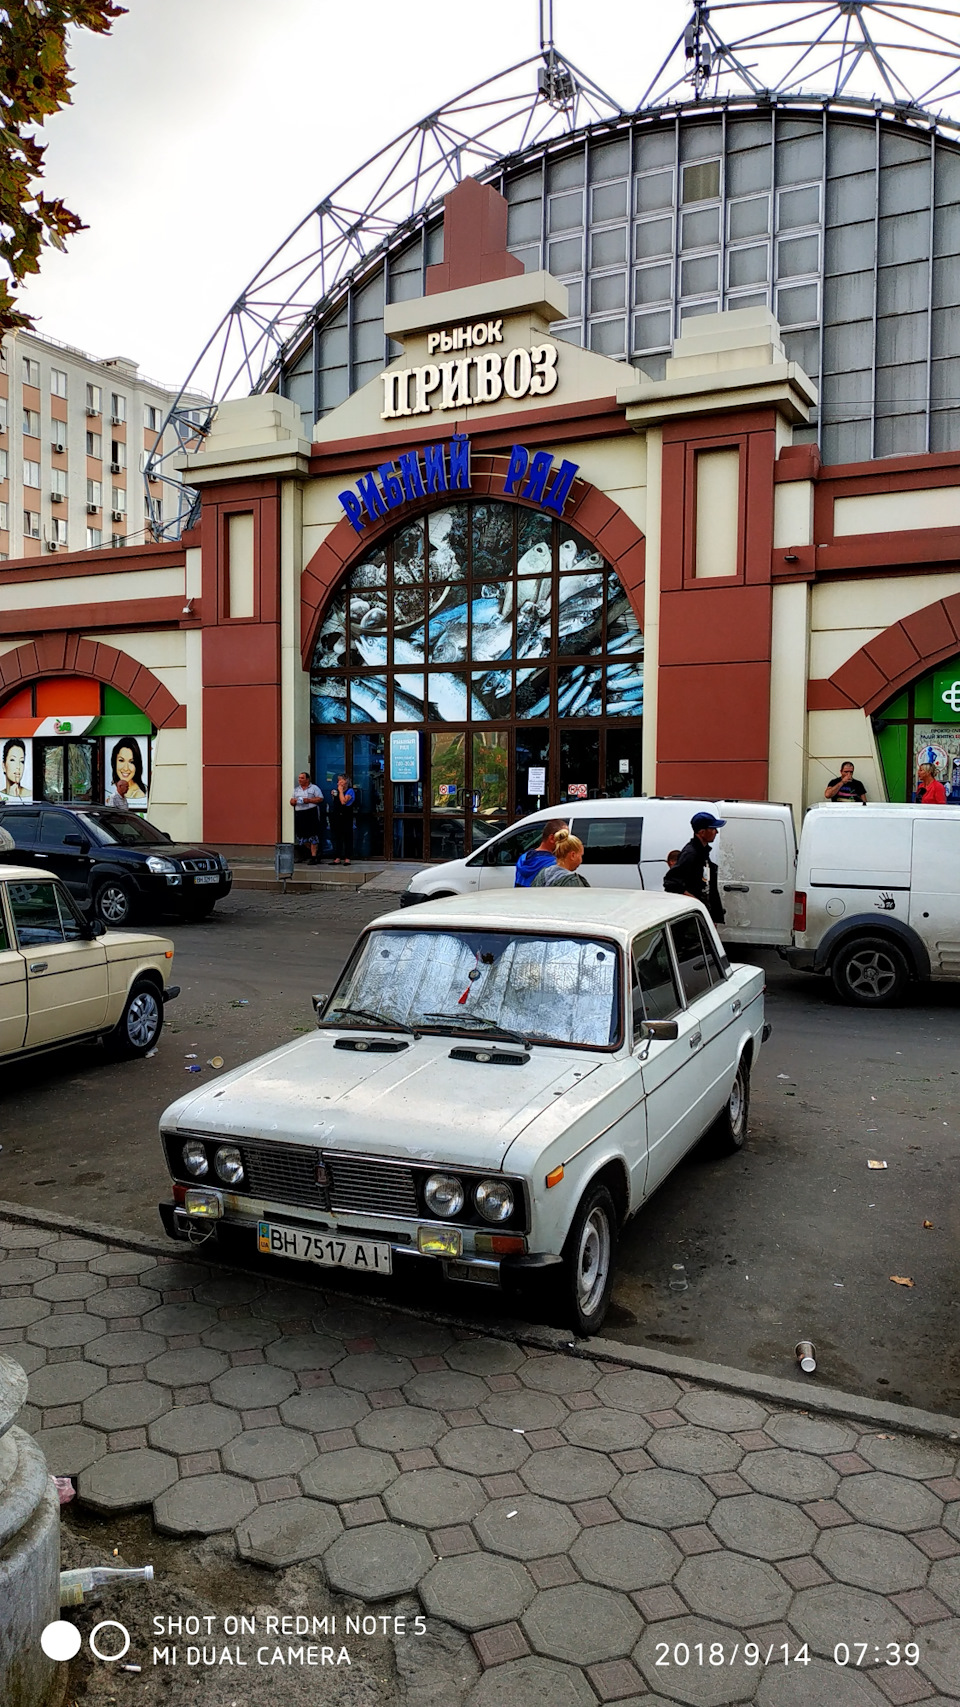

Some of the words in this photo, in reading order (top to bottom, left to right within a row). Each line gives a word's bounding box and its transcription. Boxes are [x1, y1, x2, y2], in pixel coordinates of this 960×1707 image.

[428, 319, 503, 354] РЫНОК
[380, 344, 558, 419] ПРИВОЗ
[338, 434, 471, 532] РИБНИЙ
[504, 444, 580, 516] РЯД
[270, 1228, 297, 1255] BH
[301, 1235, 347, 1263] 7517
[354, 1245, 380, 1268] AI
